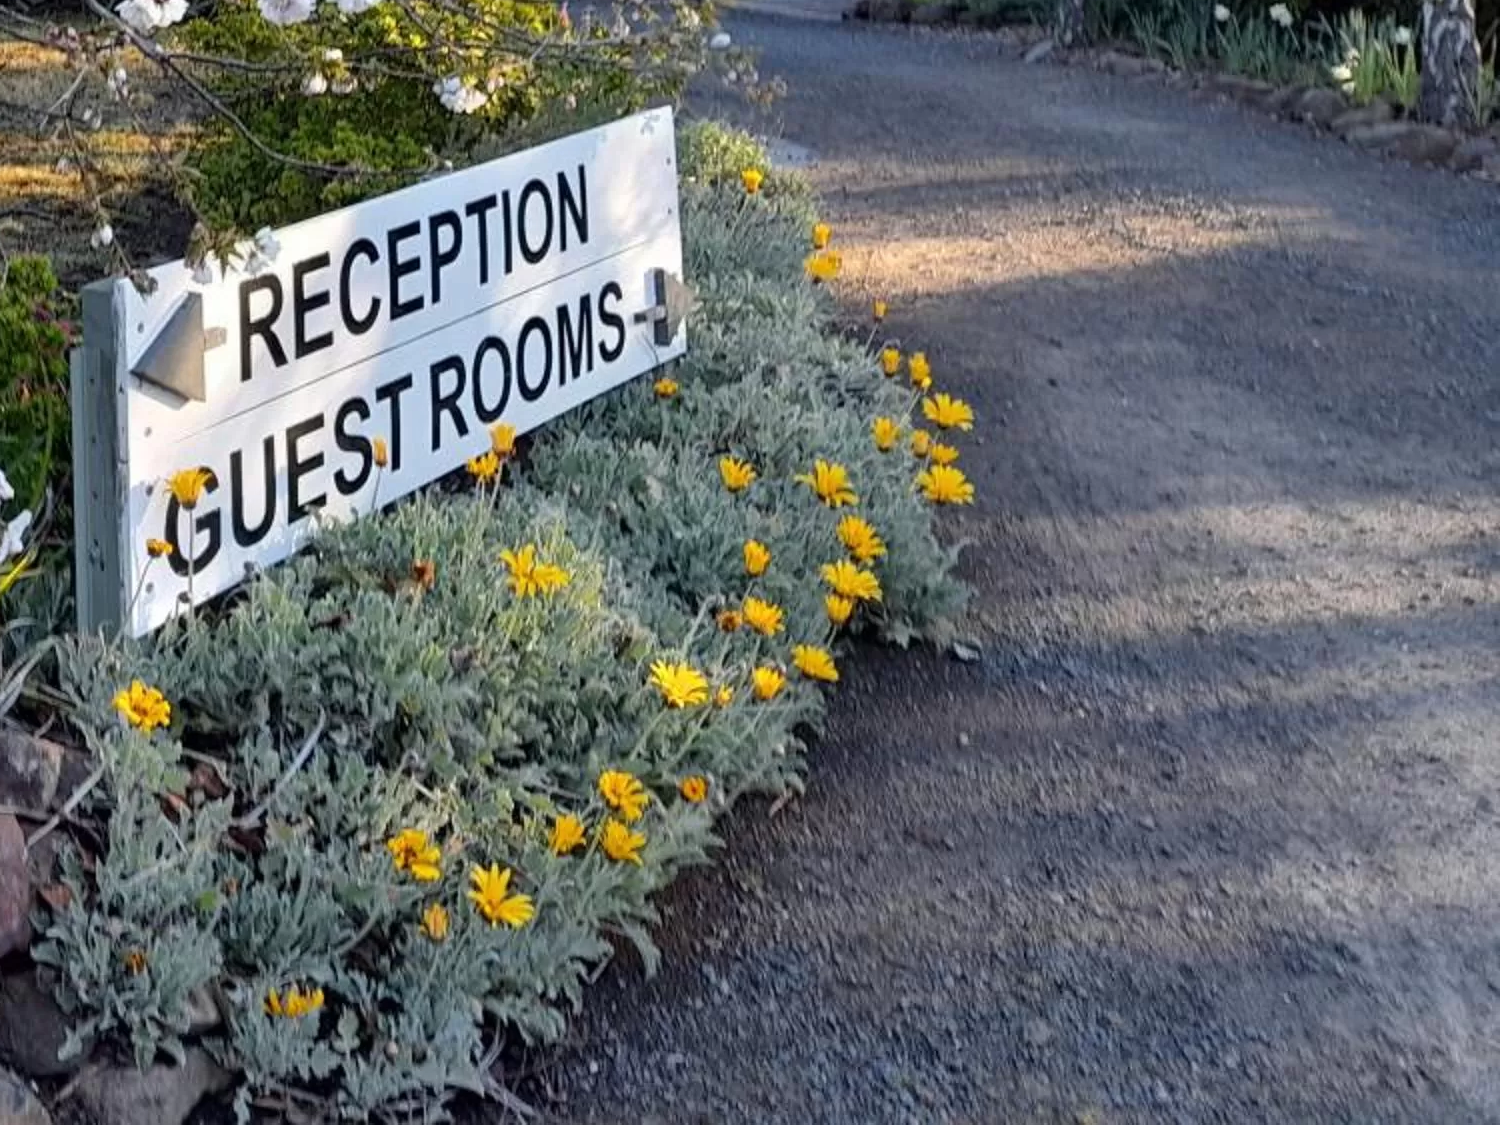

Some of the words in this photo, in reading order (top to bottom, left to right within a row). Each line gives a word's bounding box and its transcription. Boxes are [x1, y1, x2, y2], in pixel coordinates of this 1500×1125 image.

[239, 164, 589, 381] RECEPTION
[165, 374, 413, 576] GUEST
[431, 281, 626, 451] ROOMS
